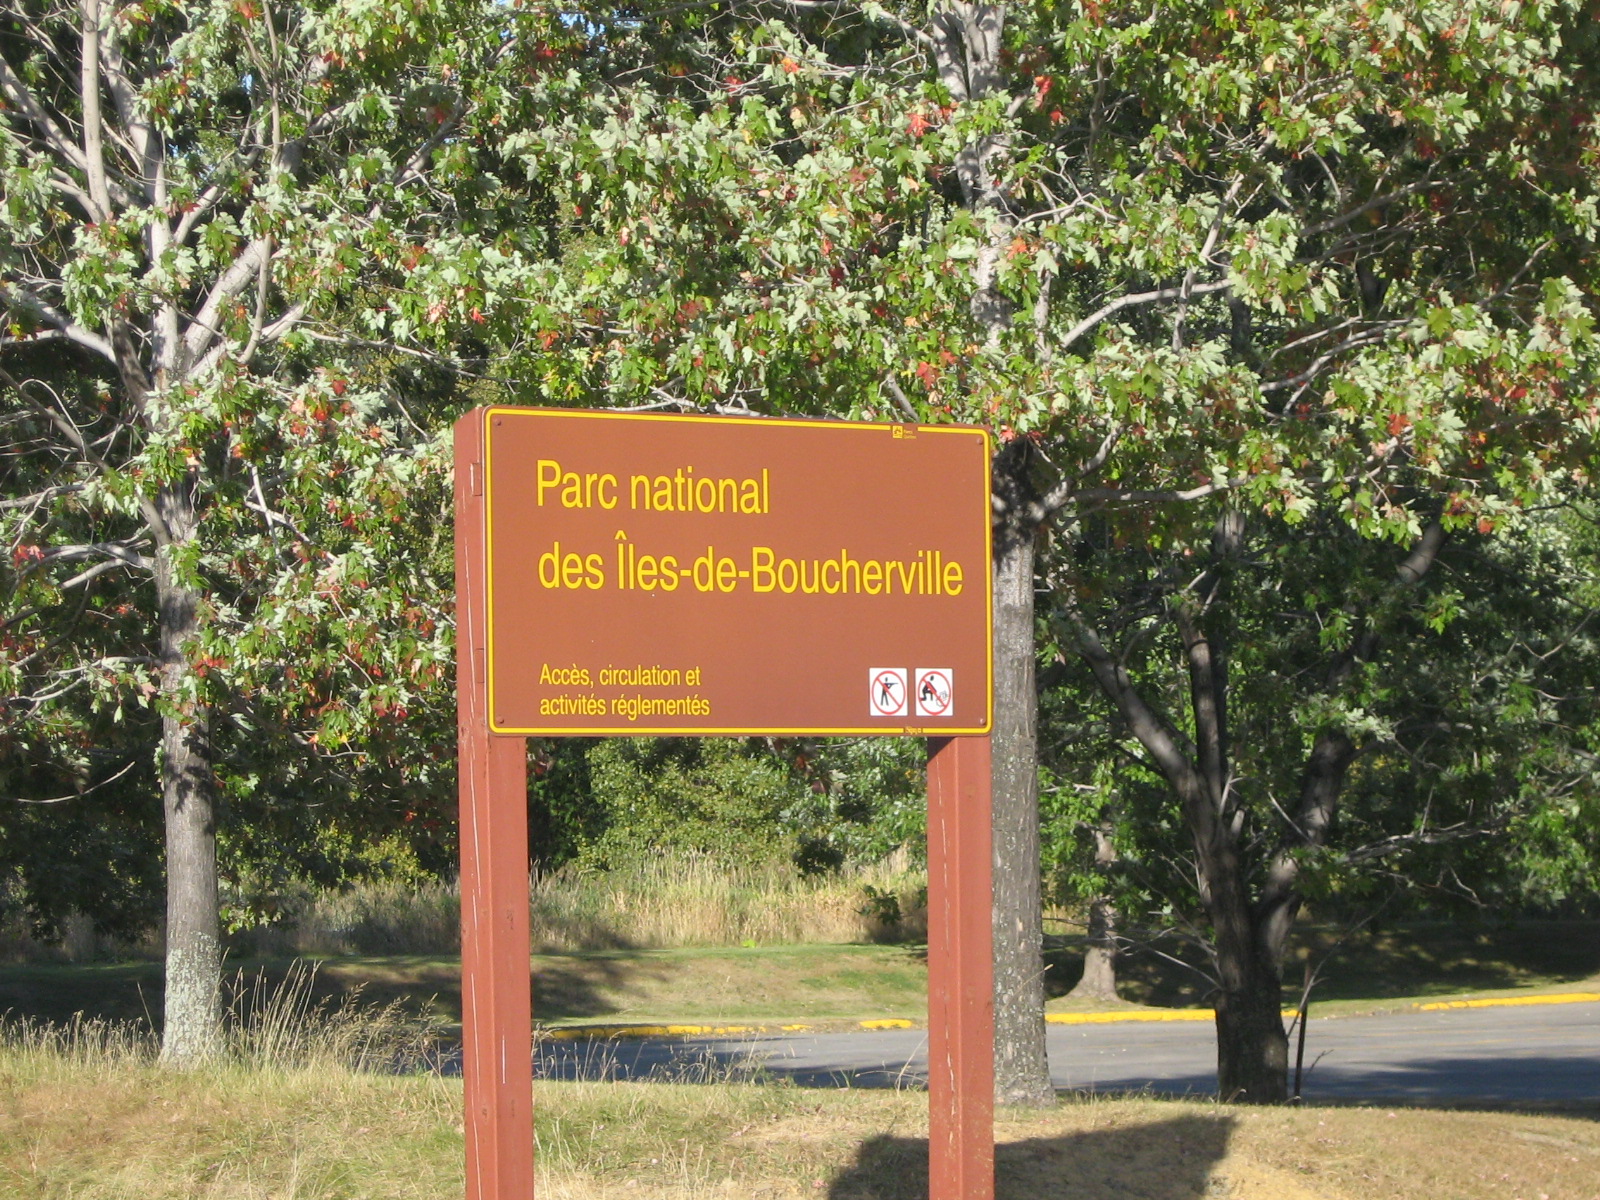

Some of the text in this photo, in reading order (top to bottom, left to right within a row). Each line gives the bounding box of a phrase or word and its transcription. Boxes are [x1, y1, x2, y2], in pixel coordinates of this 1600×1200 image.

[537, 459, 769, 514] Parc national
[538, 530, 964, 596] des Îles-de-Boucherville
[540, 664, 701, 688] Accès, circulation et
[540, 694, 711, 721] activités réglementés
